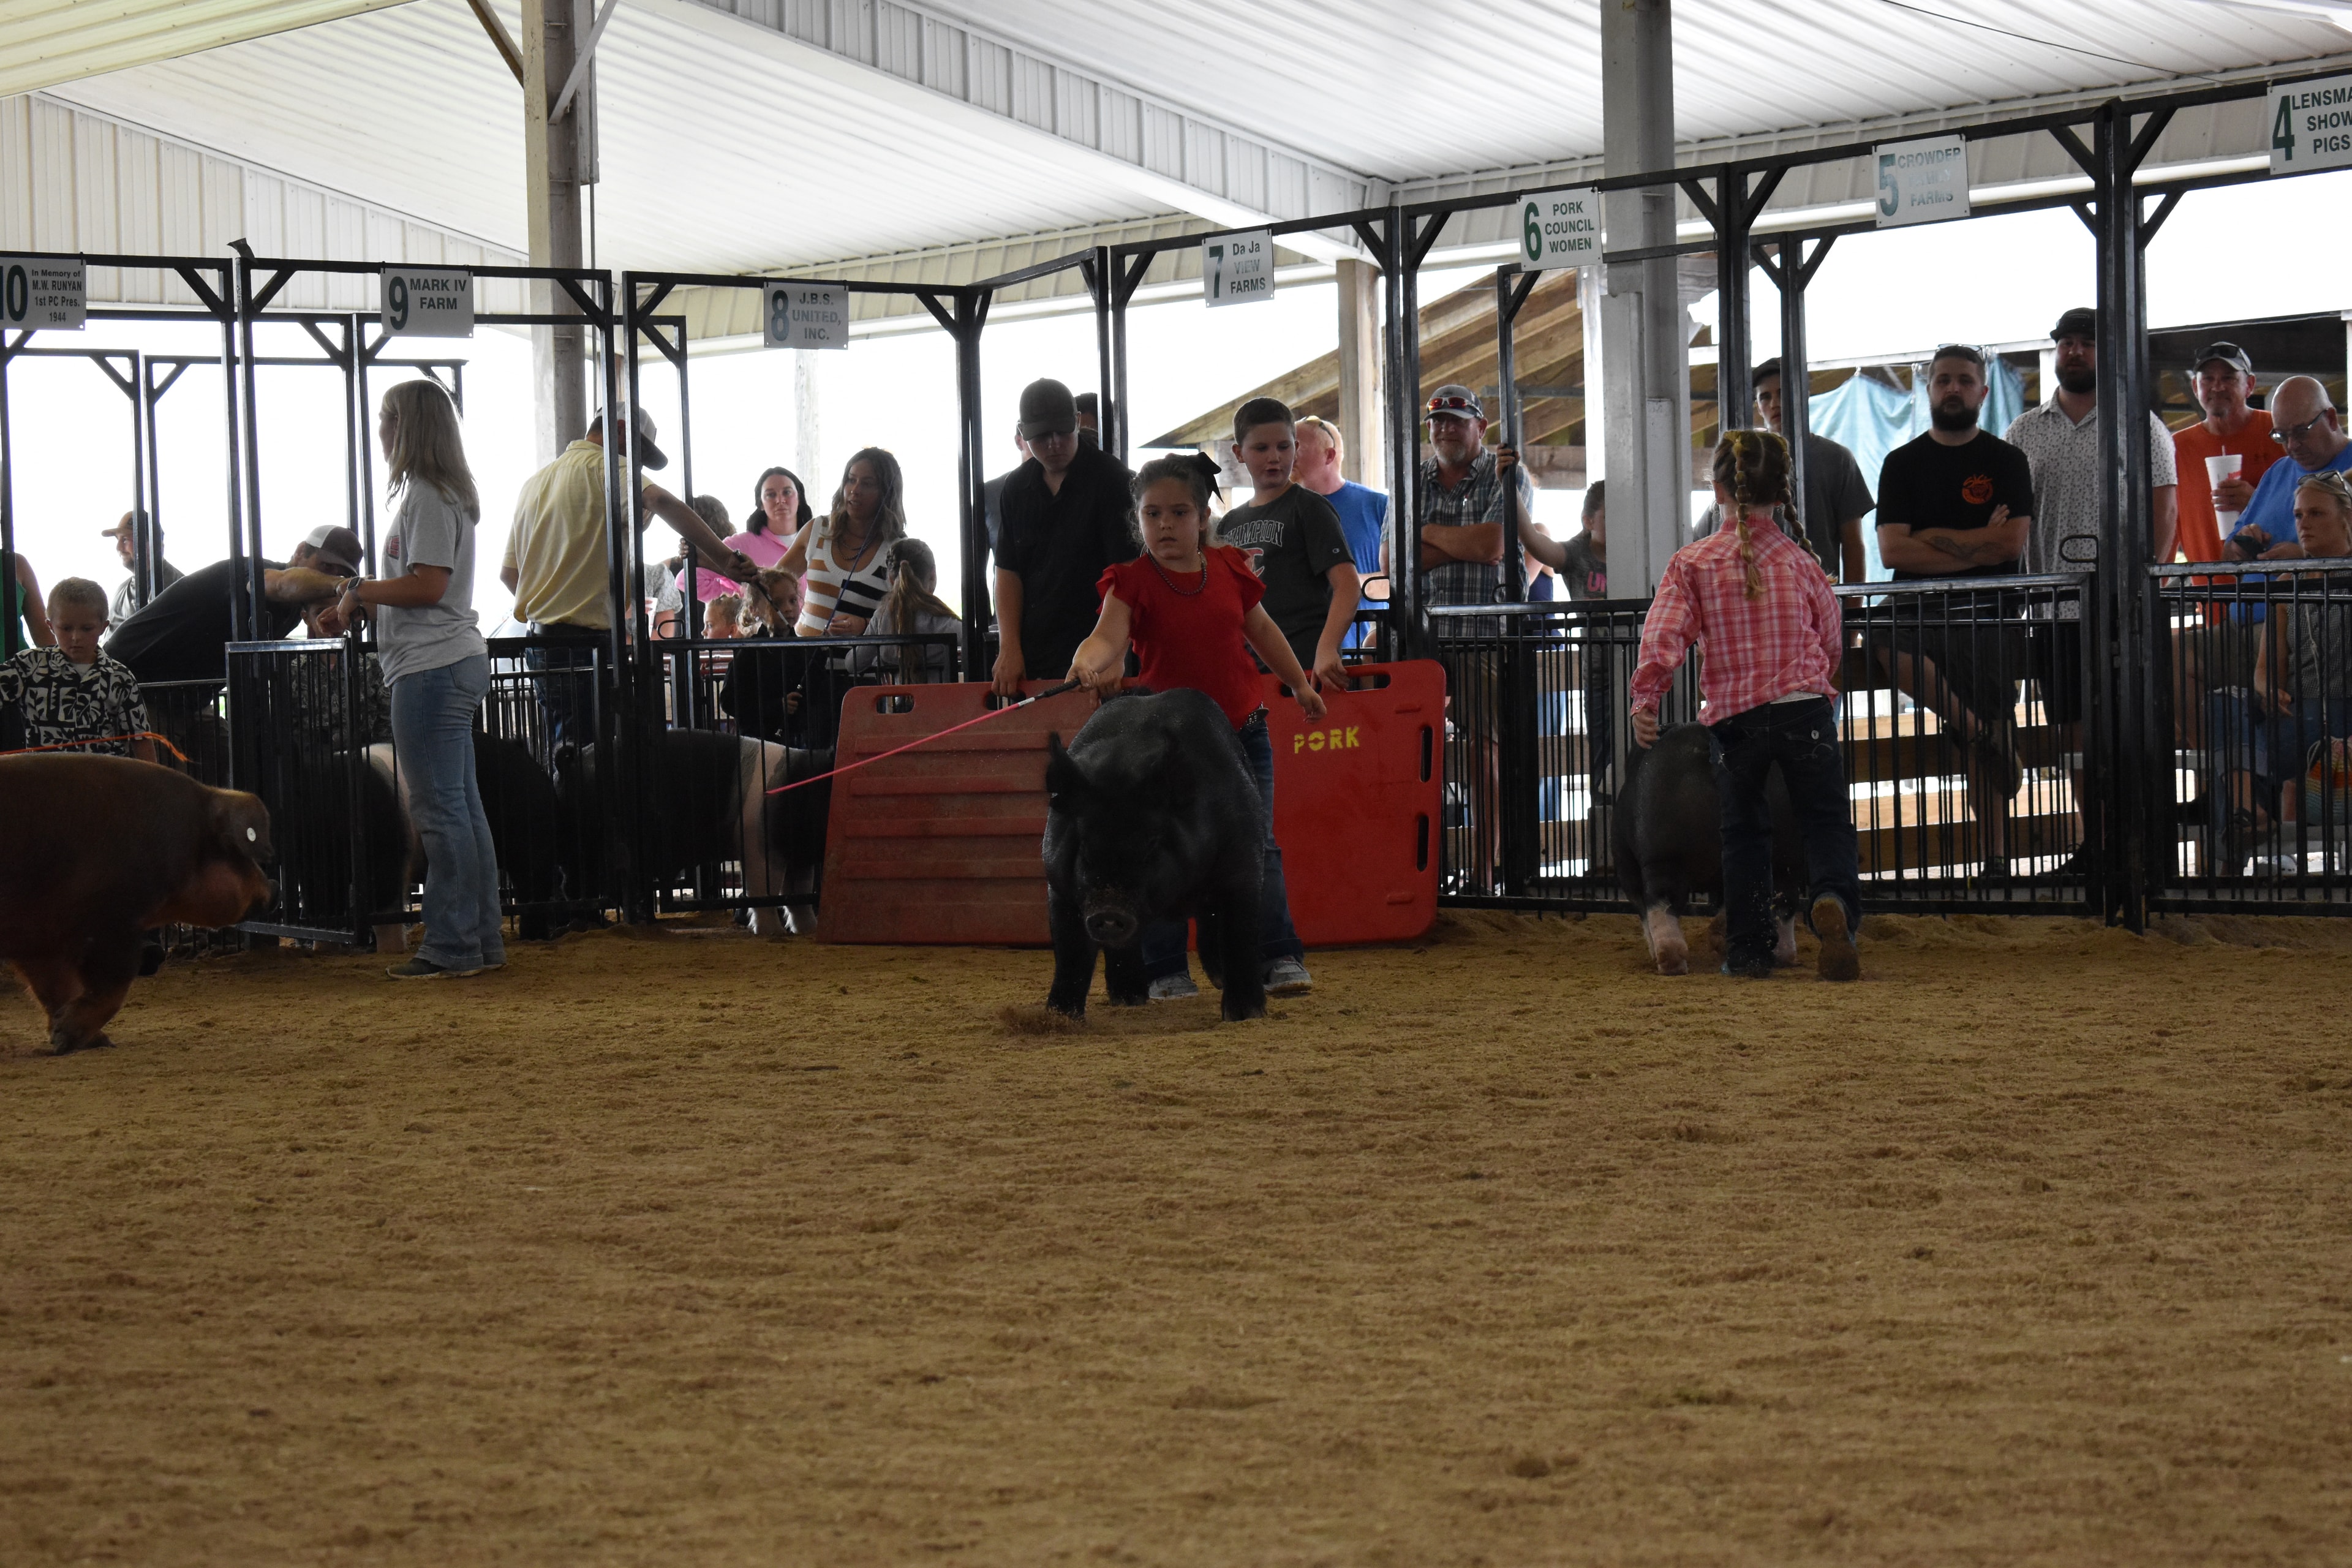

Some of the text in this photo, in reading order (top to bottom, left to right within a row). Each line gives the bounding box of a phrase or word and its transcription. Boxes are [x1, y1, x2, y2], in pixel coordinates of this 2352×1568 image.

[2272, 96, 2295, 161] 4
[2307, 111, 2352, 132] SHOW
[2313, 134, 2351, 154] PIGS
[1898, 147, 1961, 168] CROWDER
[1879, 153, 1899, 216] 5
[1910, 190, 1953, 206] FARMS
[1553, 201, 1583, 216] PORK
[1524, 202, 1542, 262] 6
[1545, 219, 1594, 235] COUNCIL
[1233, 241, 1260, 255] Da Ja
[1549, 237, 1592, 253] WOMEN
[1209, 245, 1224, 298] 7
[1234, 258, 1260, 274] VIEW
[41, 270, 71, 279] Memory
[32, 280, 82, 291] M.W. RUNYAN
[410, 278, 467, 292] MARK IV
[1231, 277, 1265, 294] FARMS
[35, 296, 80, 306] 1st PC Pres.
[388, 276, 409, 330] 9
[420, 297, 458, 309] FARM
[799, 293, 834, 305] J.B.S.
[50, 312, 66, 322] 1944
[771, 290, 790, 341] 8
[792, 309, 841, 326] UNITED,
[804, 328, 829, 340] INC.
[1294, 726, 1359, 754] PORK
